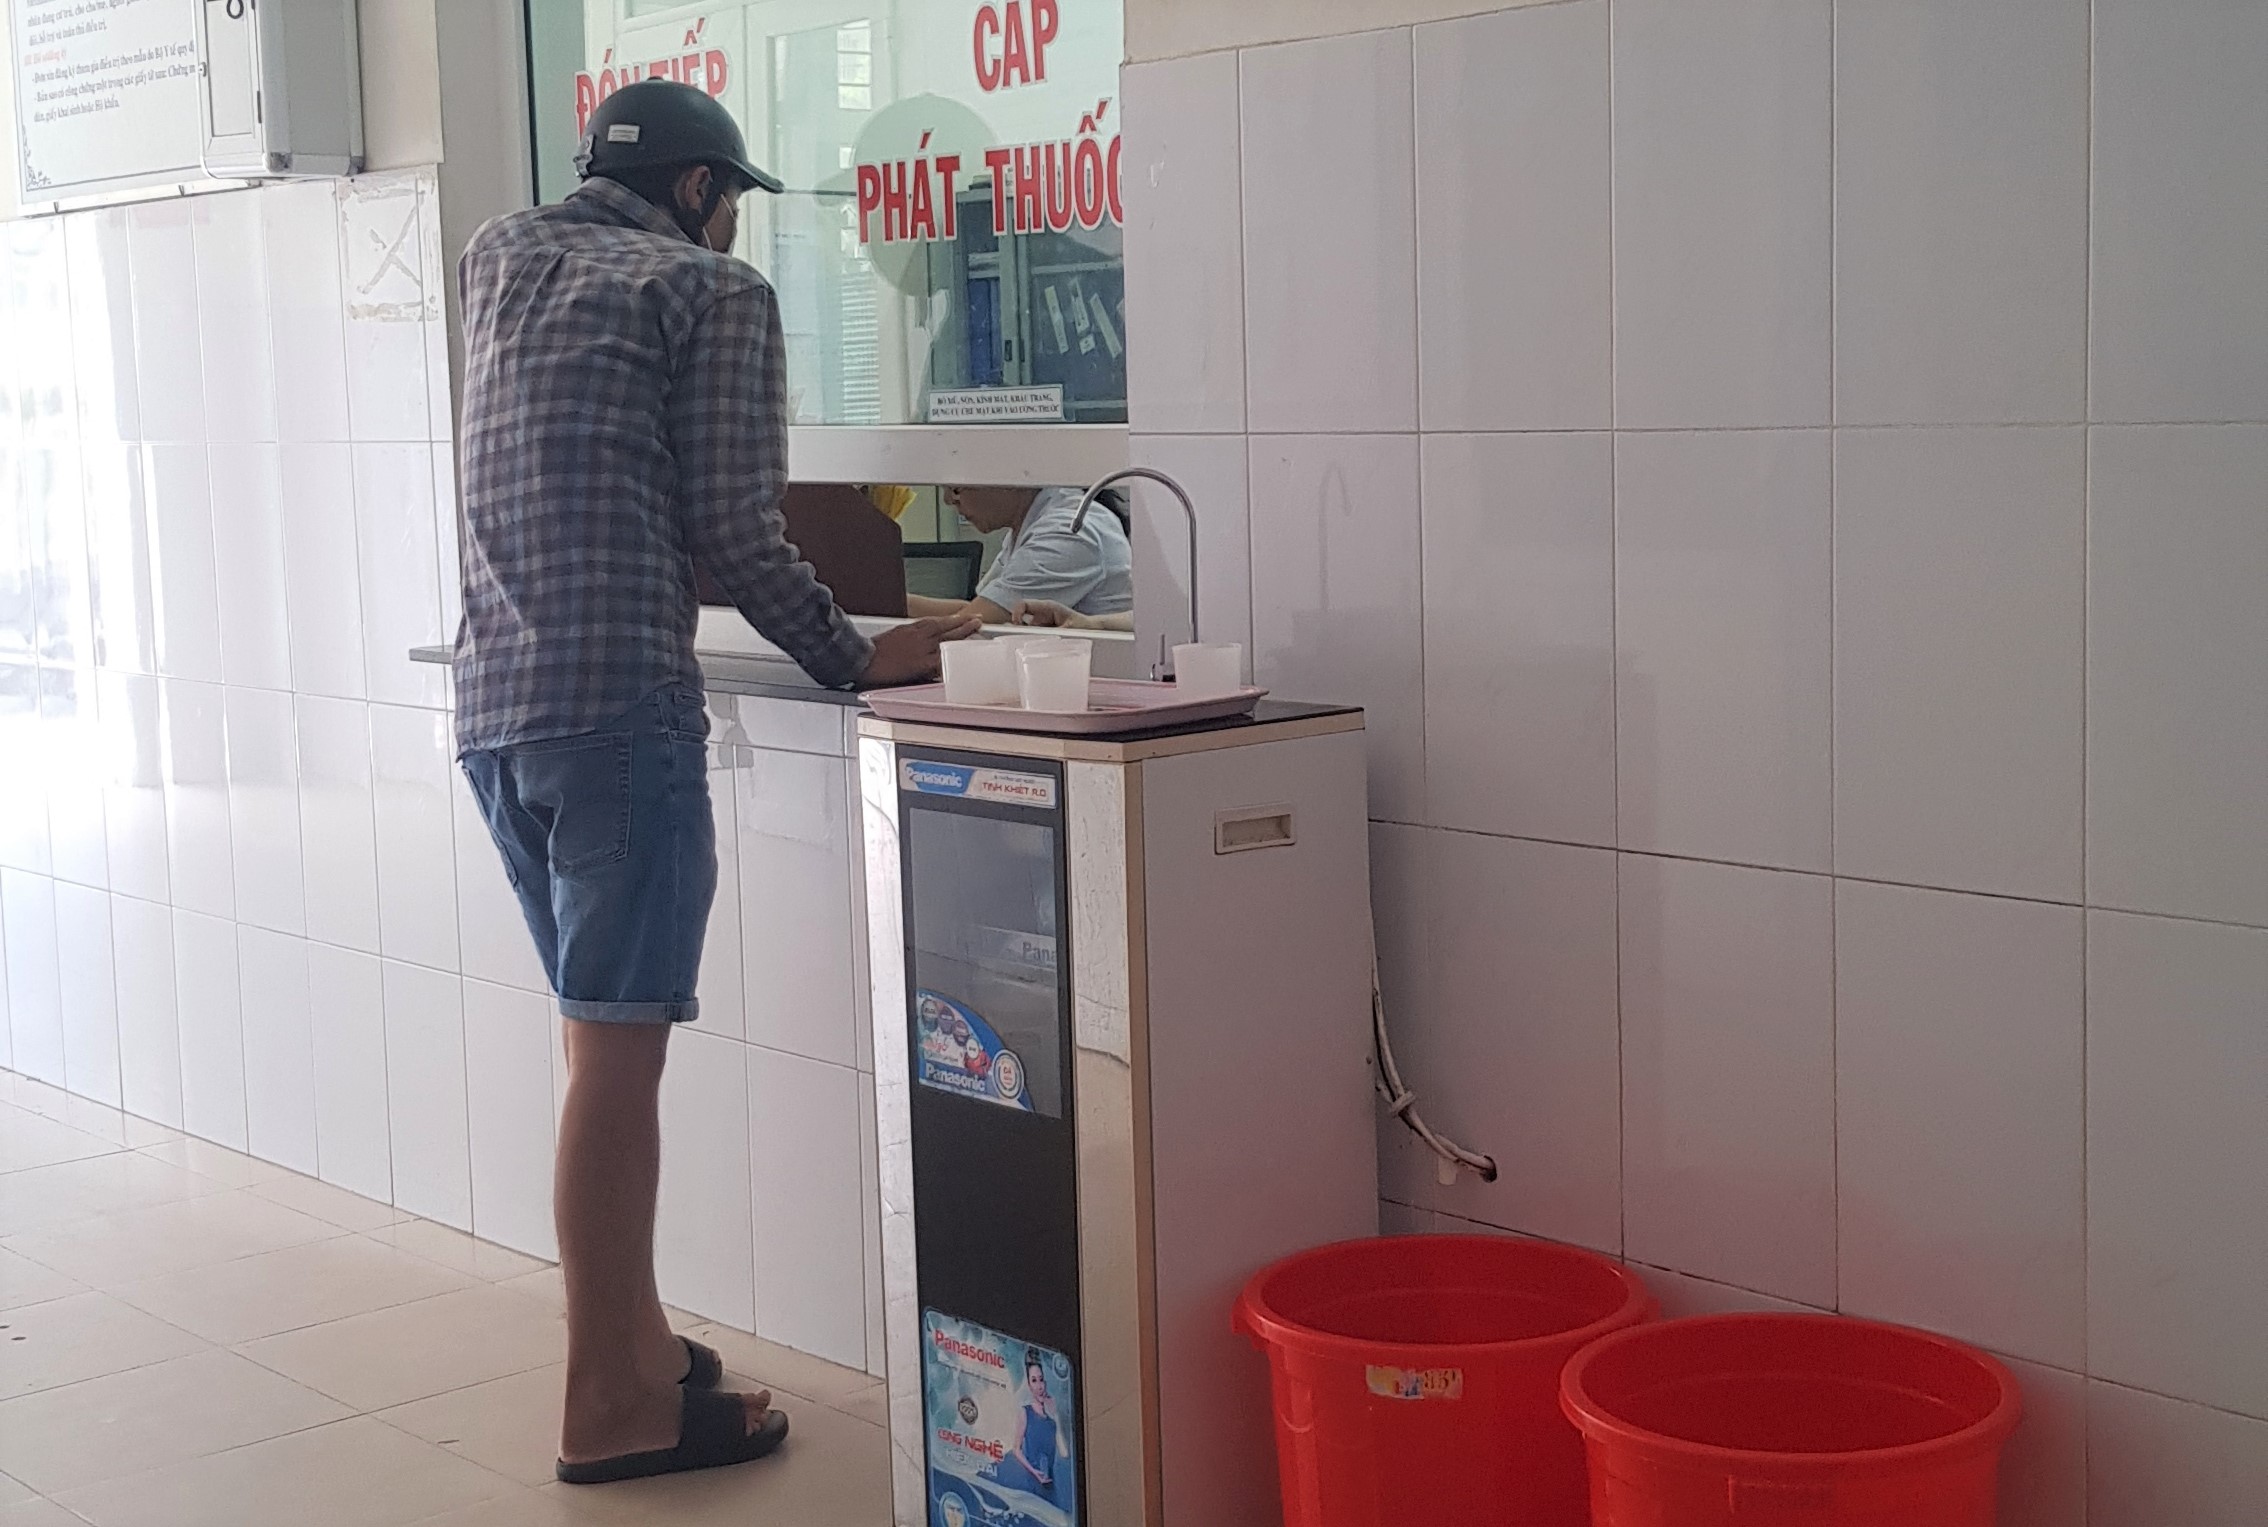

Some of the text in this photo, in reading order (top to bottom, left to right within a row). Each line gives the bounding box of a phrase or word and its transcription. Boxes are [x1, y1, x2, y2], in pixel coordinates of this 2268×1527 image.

[648, 18, 728, 99] ẾP
[856, 129, 960, 244] PHÁT
[905, 765, 964, 789] Panasonic
[925, 1062, 985, 1092] Panasonic
[934, 1328, 1006, 1369] Panasonic
